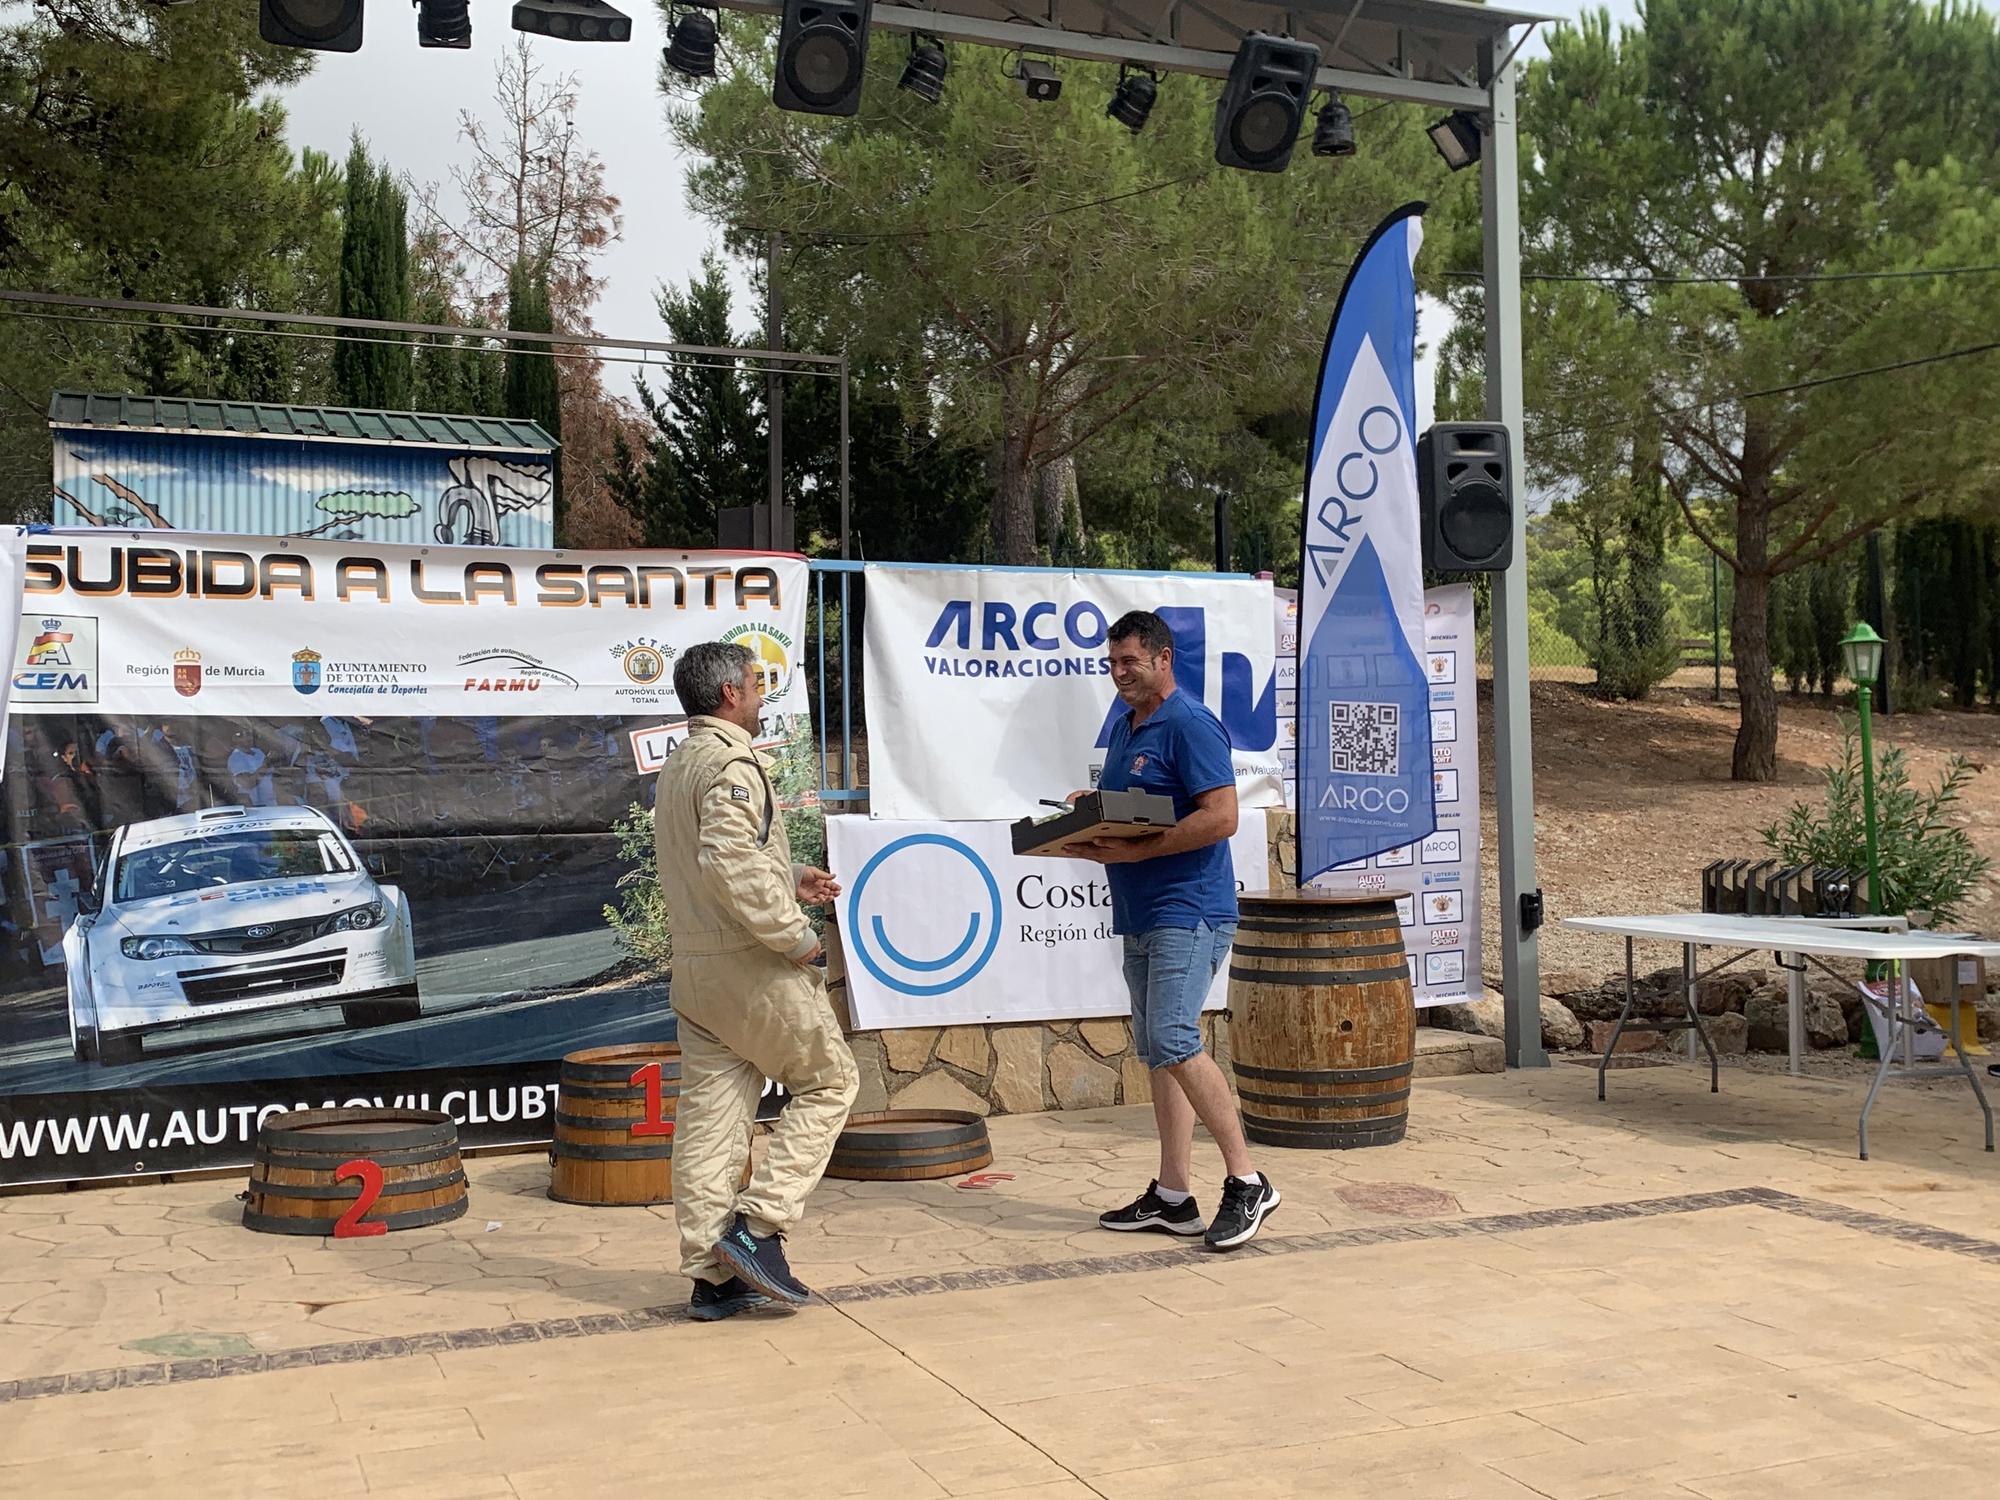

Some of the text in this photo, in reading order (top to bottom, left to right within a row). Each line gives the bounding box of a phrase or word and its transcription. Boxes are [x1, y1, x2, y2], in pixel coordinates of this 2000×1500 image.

[1306, 405, 1402, 589] ARCO
[24, 544, 782, 611] SUBIDA A LA SANTA
[925, 600, 1109, 651] ARCO
[627, 637, 657, 650] ACT
[126, 664, 265, 677] Región de Murcia
[326, 663, 427, 672] AYUNTAMIENTO
[924, 656, 1111, 677] VALORACIONES
[12, 673, 88, 690] CEM
[326, 674, 398, 683] DE TOTANA
[464, 678, 540, 691] FARMU
[328, 684, 427, 696] Concejalía de Deportes
[615, 687, 656, 695] AUTOMÓVIL
[646, 736, 678, 760] LA
[1319, 783, 1409, 814] ARCO
[1425, 841, 1457, 852] ARCO
[1020, 922, 1116, 947] Región de
[1432, 929, 1458, 939] AUTO
[630, 1062, 676, 1137] 1
[334, 1159, 388, 1239] 2
[736, 1230, 757, 1254] HOKA
